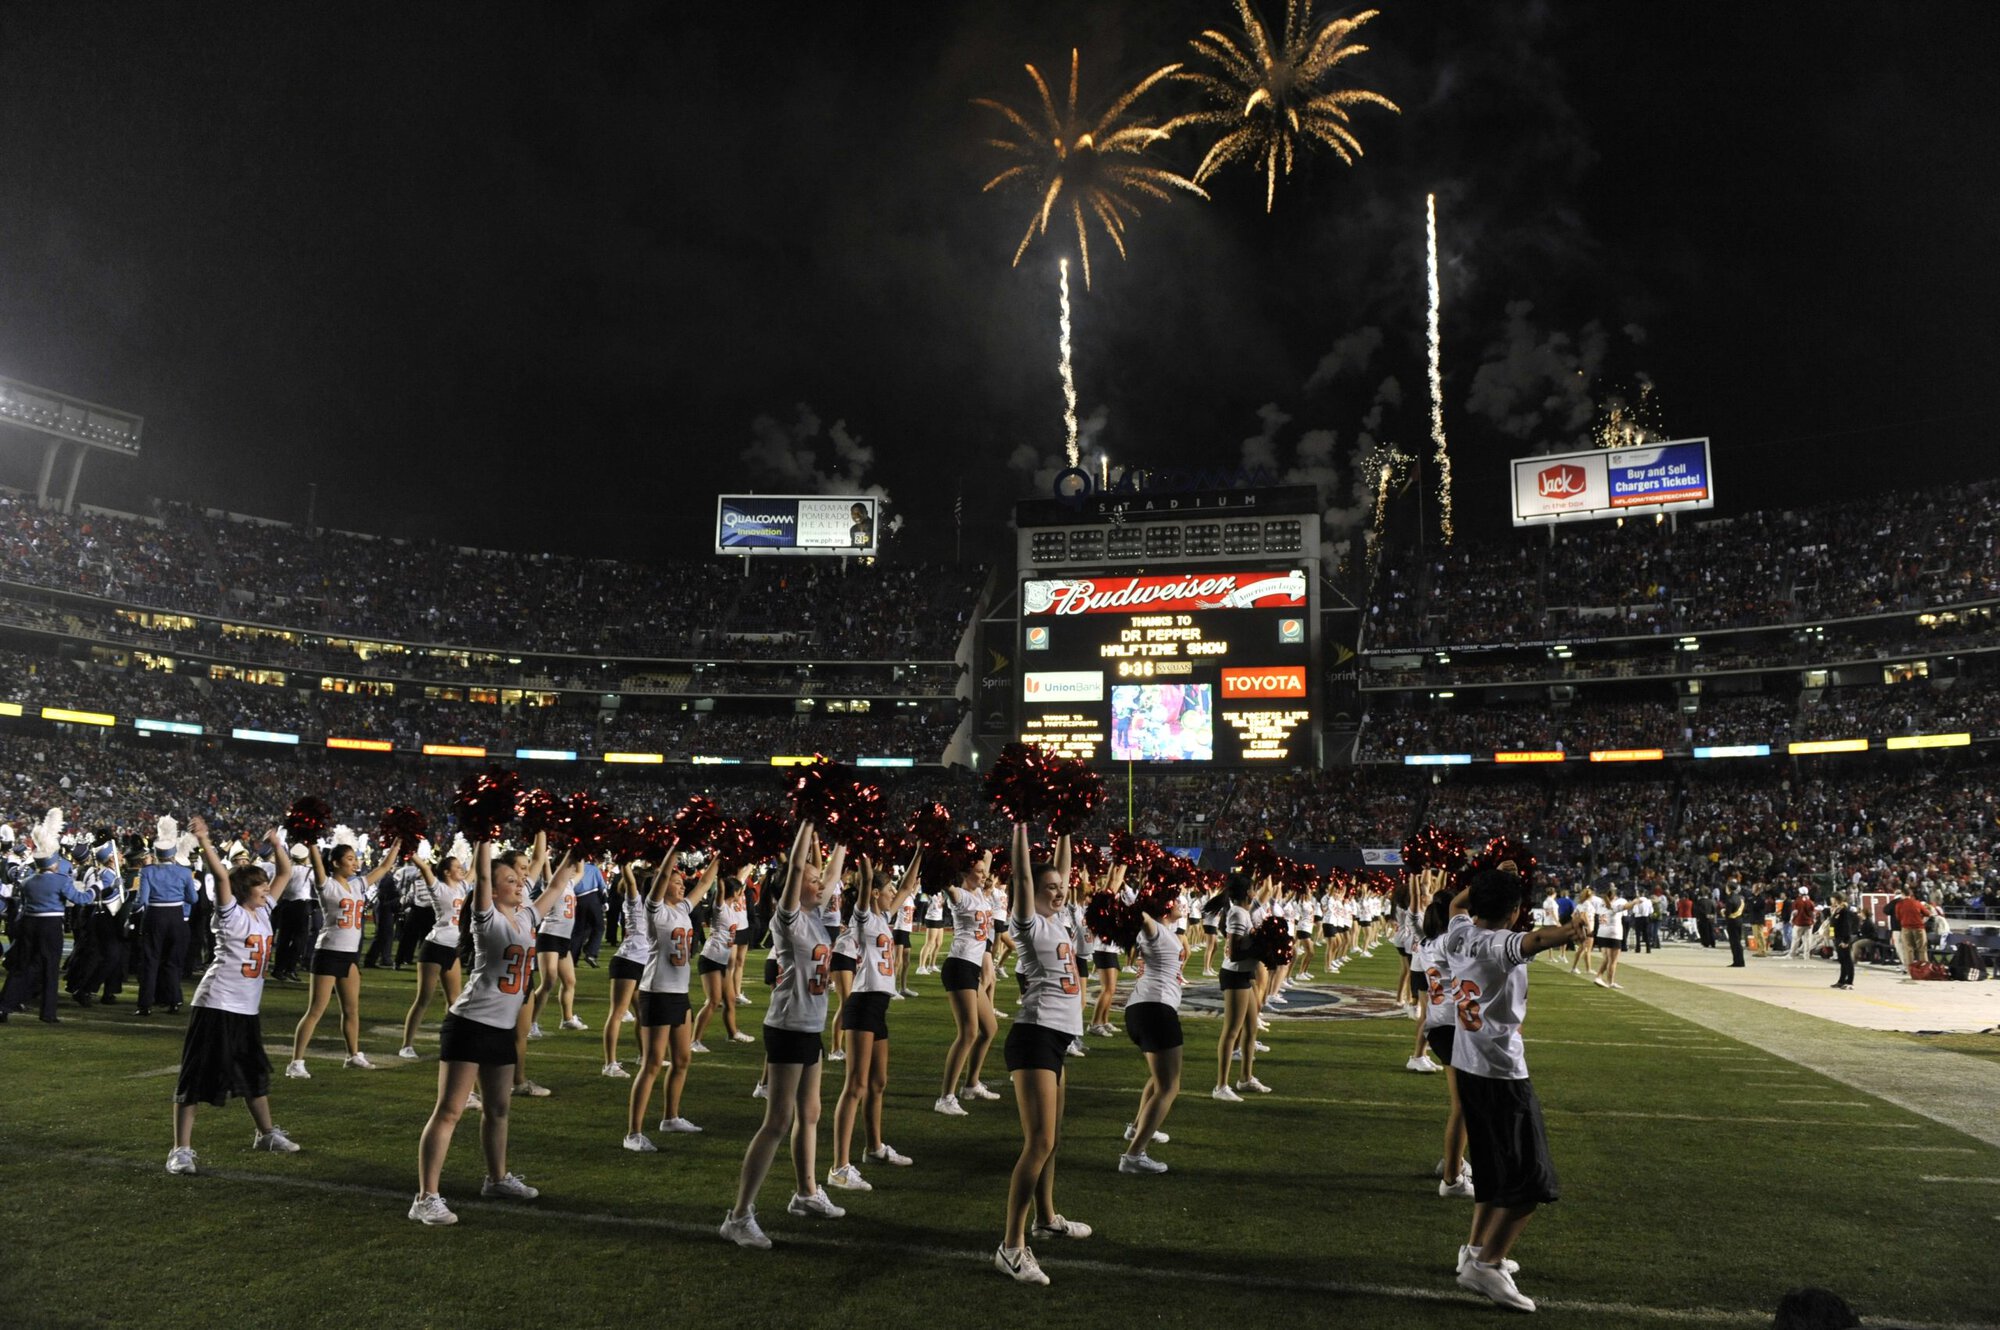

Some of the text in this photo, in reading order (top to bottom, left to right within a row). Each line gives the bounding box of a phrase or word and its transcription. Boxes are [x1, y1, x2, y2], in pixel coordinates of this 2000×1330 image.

[1627, 464, 1686, 480] Buy and Sell
[1540, 468, 1585, 496] Jack
[1615, 474, 1700, 494] Chargers Tickets!
[1099, 495, 1256, 514] STADIUM
[1614, 491, 1703, 504] NFL.COM/TICKETEXCHANGE
[801, 503, 849, 512] PALOMAR
[1552, 502, 1567, 510] the
[1568, 501, 1584, 509] box
[724, 512, 794, 528] QUALCOMM
[801, 512, 849, 520] POMERADO
[737, 527, 782, 536] Innovation
[801, 521, 849, 529] HEALTH
[805, 537, 845, 545] www.pph.org
[1050, 574, 1236, 615] Budweiser
[1237, 582, 1303, 602] American Lager
[1131, 615, 1192, 627] THANKS TO
[1121, 628, 1201, 643] DR PEPPER
[1101, 641, 1228, 657] HALFTIME SHOW
[1117, 660, 1155, 676] 9:36
[982, 677, 1012, 689] Sprint
[1225, 675, 1301, 691] TOYOTA
[1325, 670, 1358, 685] Sprint
[1044, 680, 1102, 693] UnionBank
[1497, 752, 1562, 761] WELLS FARGO
